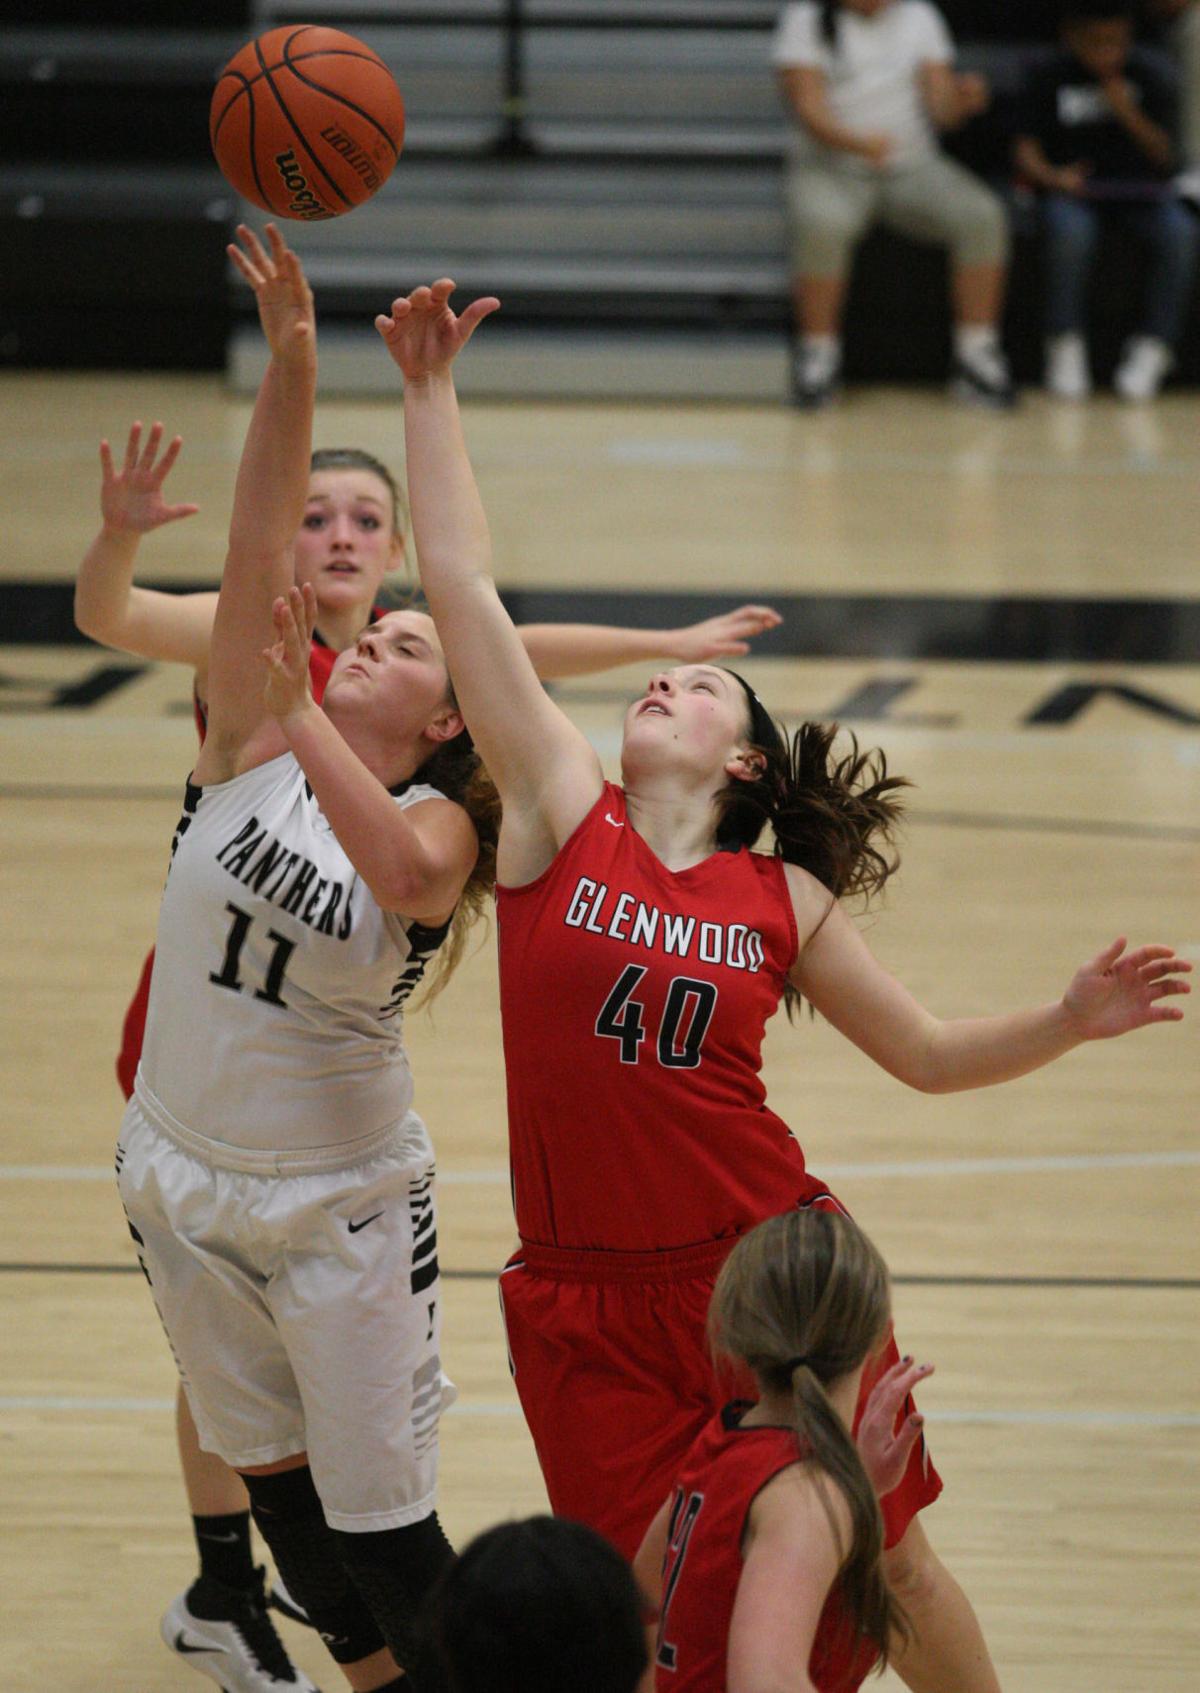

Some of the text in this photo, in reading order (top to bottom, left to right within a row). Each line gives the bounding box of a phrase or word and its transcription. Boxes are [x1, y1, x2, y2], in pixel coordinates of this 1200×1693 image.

[216, 816, 352, 940] PANTHERS
[564, 876, 766, 973] GLENWOOD
[208, 900, 298, 1009] 11
[594, 963, 718, 1069] 40
